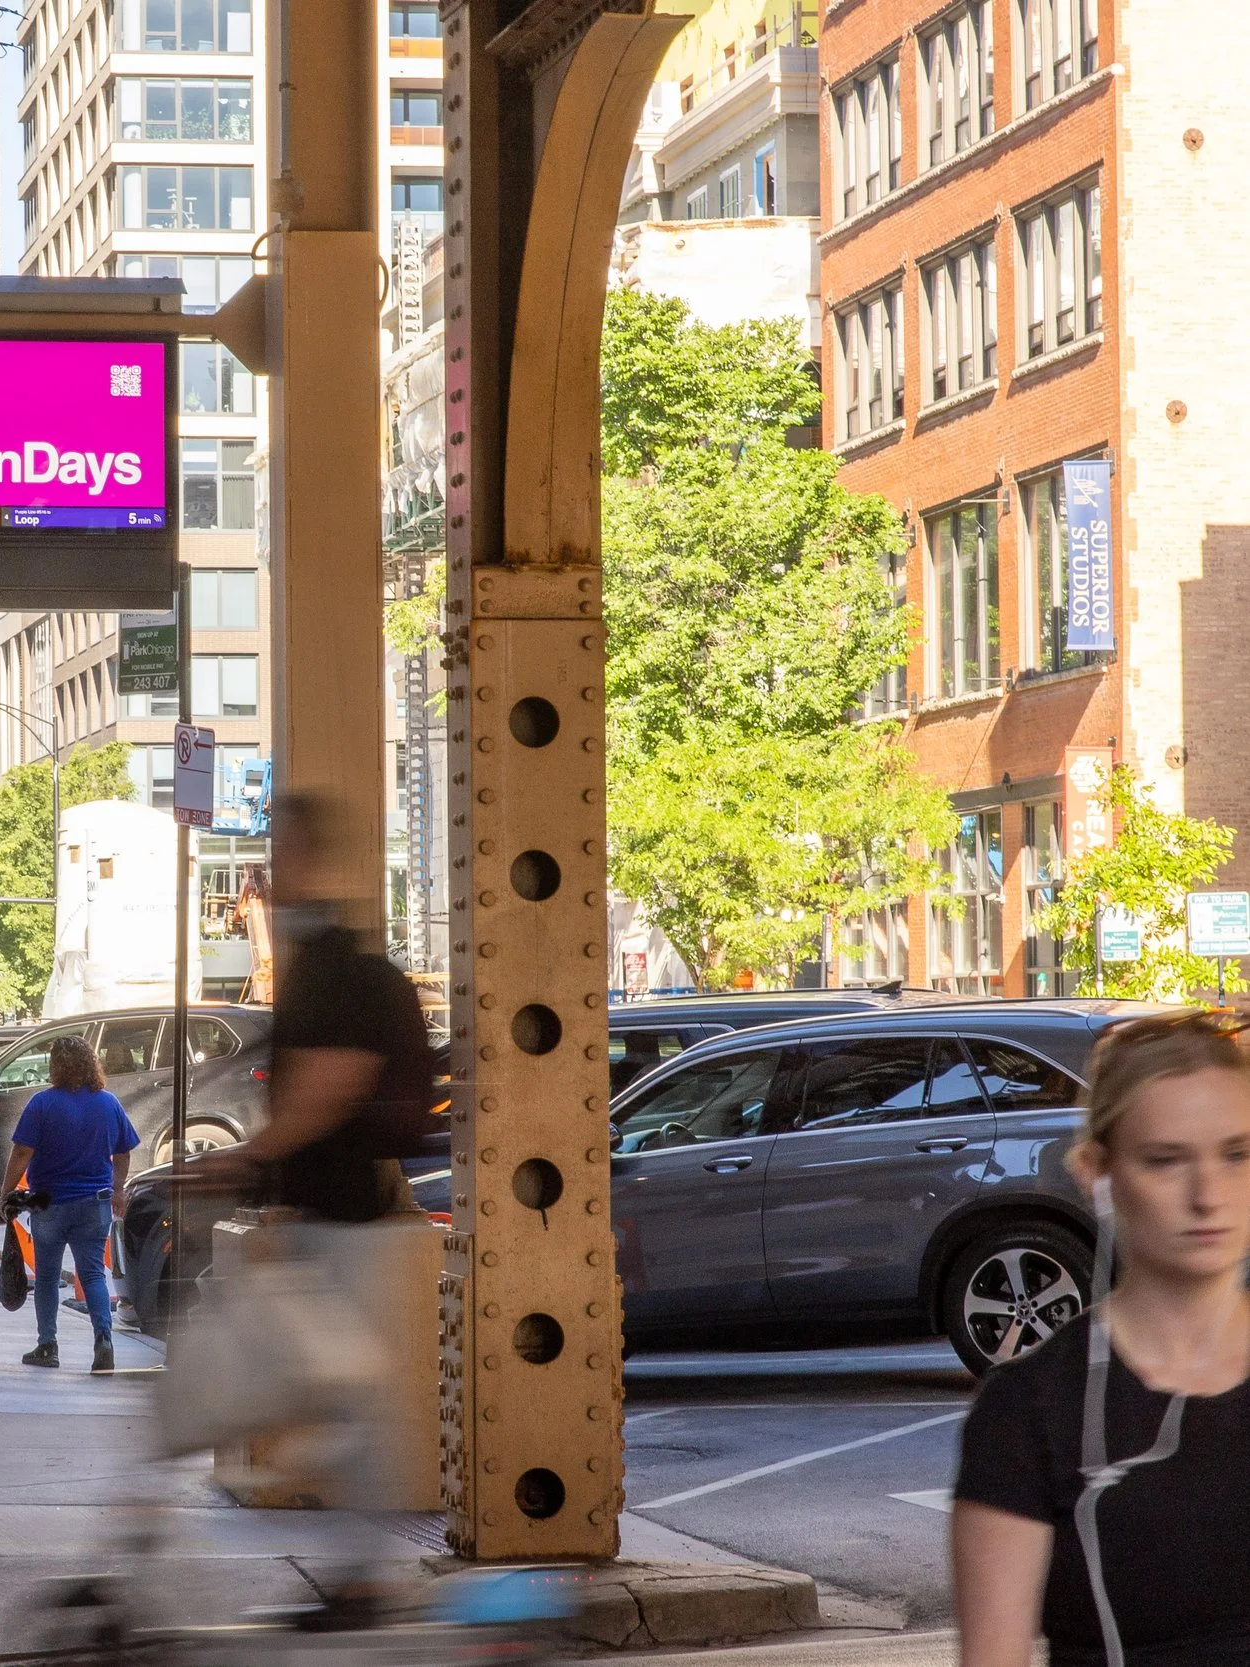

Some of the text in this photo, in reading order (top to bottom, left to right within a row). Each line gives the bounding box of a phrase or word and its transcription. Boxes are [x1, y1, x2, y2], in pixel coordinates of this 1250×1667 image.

[15, 515, 40, 526] Loop
[128, 513, 137, 524] 5
[1071, 527, 1091, 628] STUDIOS
[1090, 520, 1110, 635] SUPERIOR
[134, 676, 170, 690] 243 407
[176, 808, 210, 825] TOW ZONE
